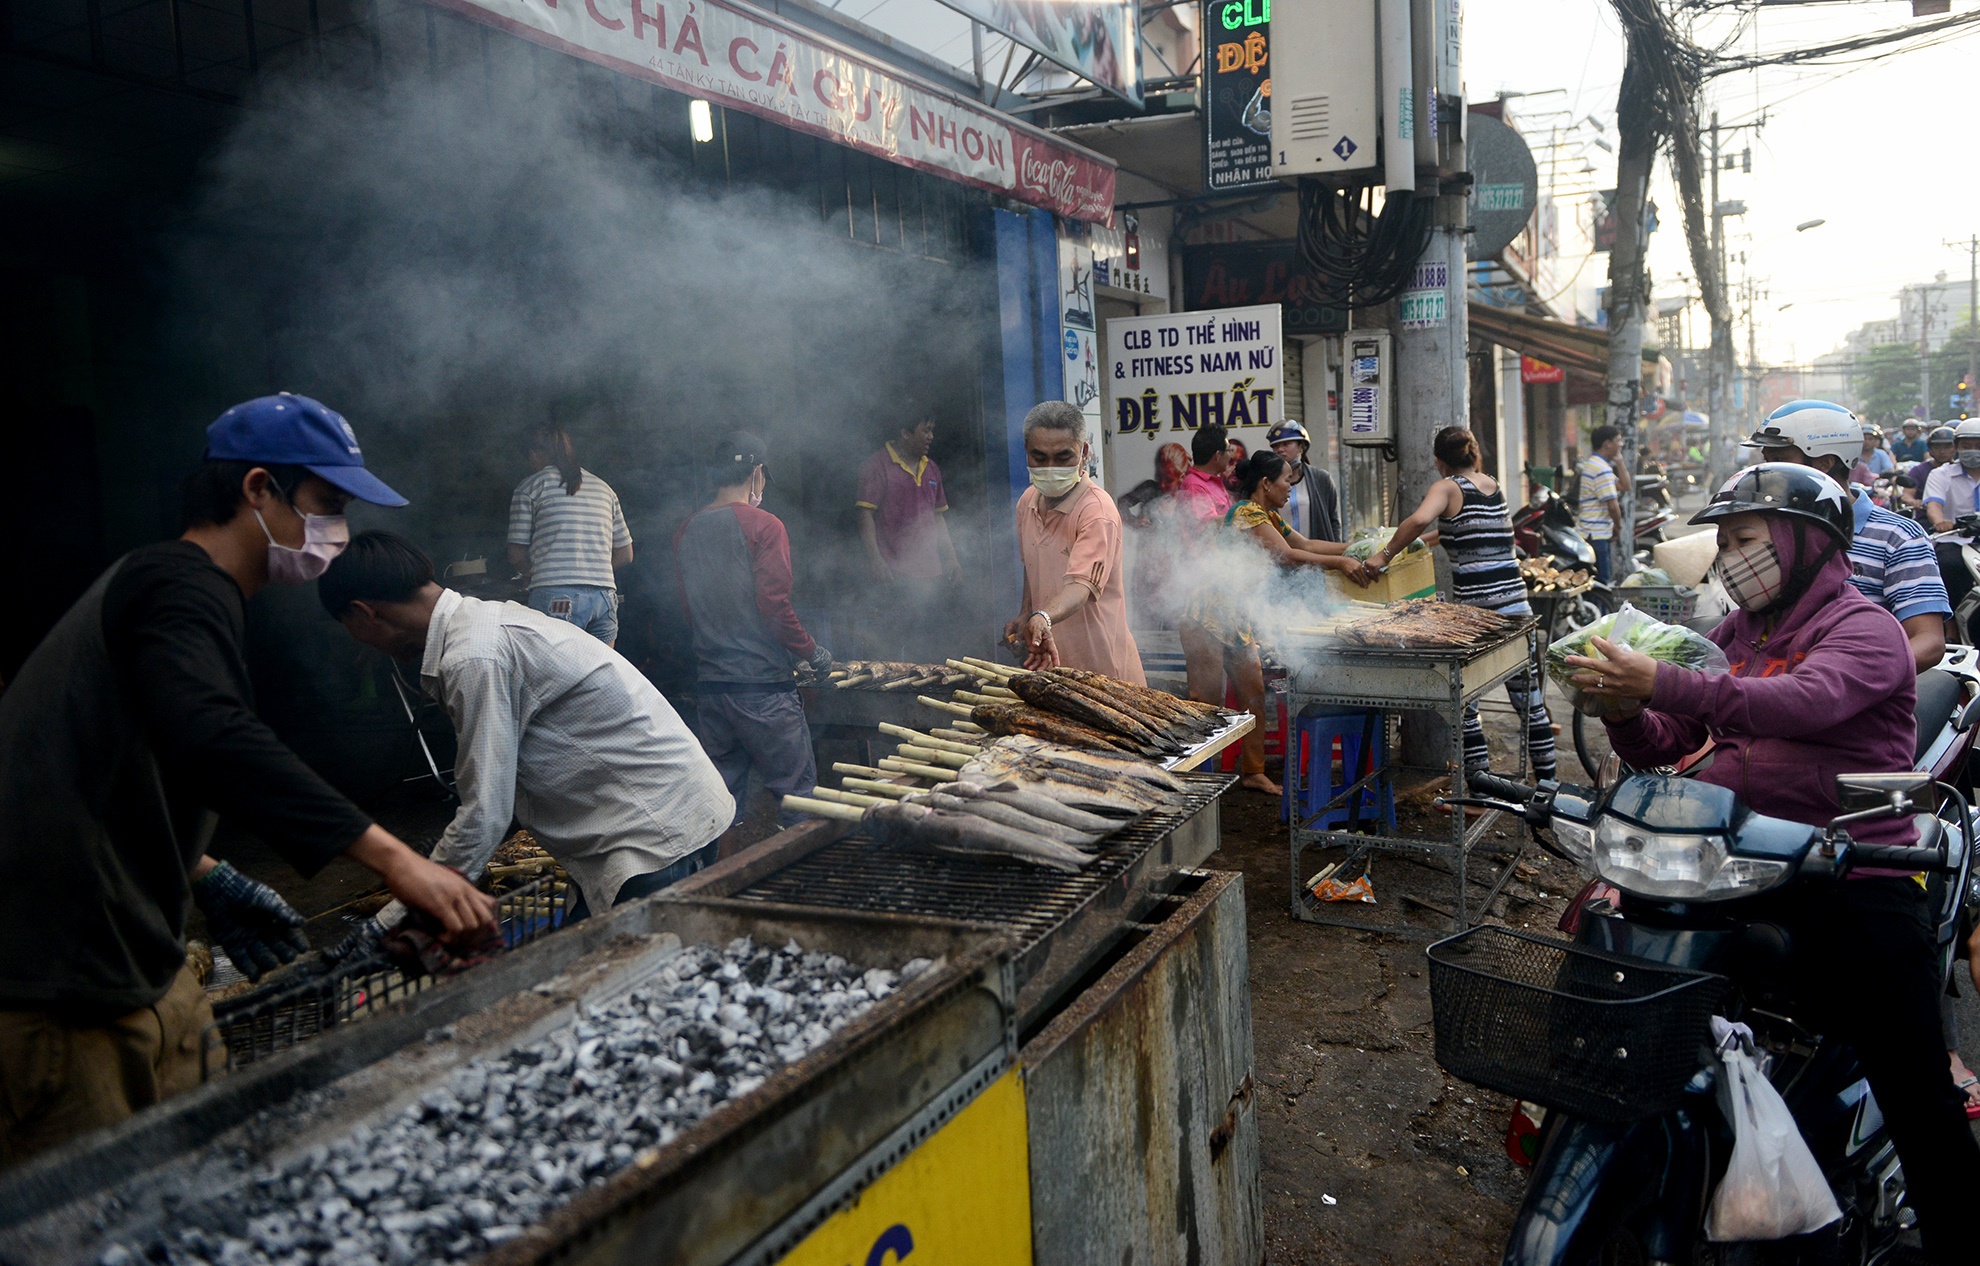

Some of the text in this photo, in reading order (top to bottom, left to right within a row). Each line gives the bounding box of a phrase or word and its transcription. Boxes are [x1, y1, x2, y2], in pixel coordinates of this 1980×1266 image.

[648, 55, 664, 70] 44
[1216, 30, 1268, 75] ĐỆ
[585, 0, 709, 67] CHẢ
[728, 36, 799, 98] CÁ
[910, 104, 1005, 172] NHƠN
[1279, 150, 1287, 165] 1
[1341, 140, 1350, 157] 1
[1216, 167, 1250, 184] NHẬN
[1123, 316, 1260, 350] CLB TD THỂ HÌNH
[1115, 346, 1274, 379] & FITNESS NAM NỮ
[1116, 377, 1276, 440] ĐỆ NHẤT
